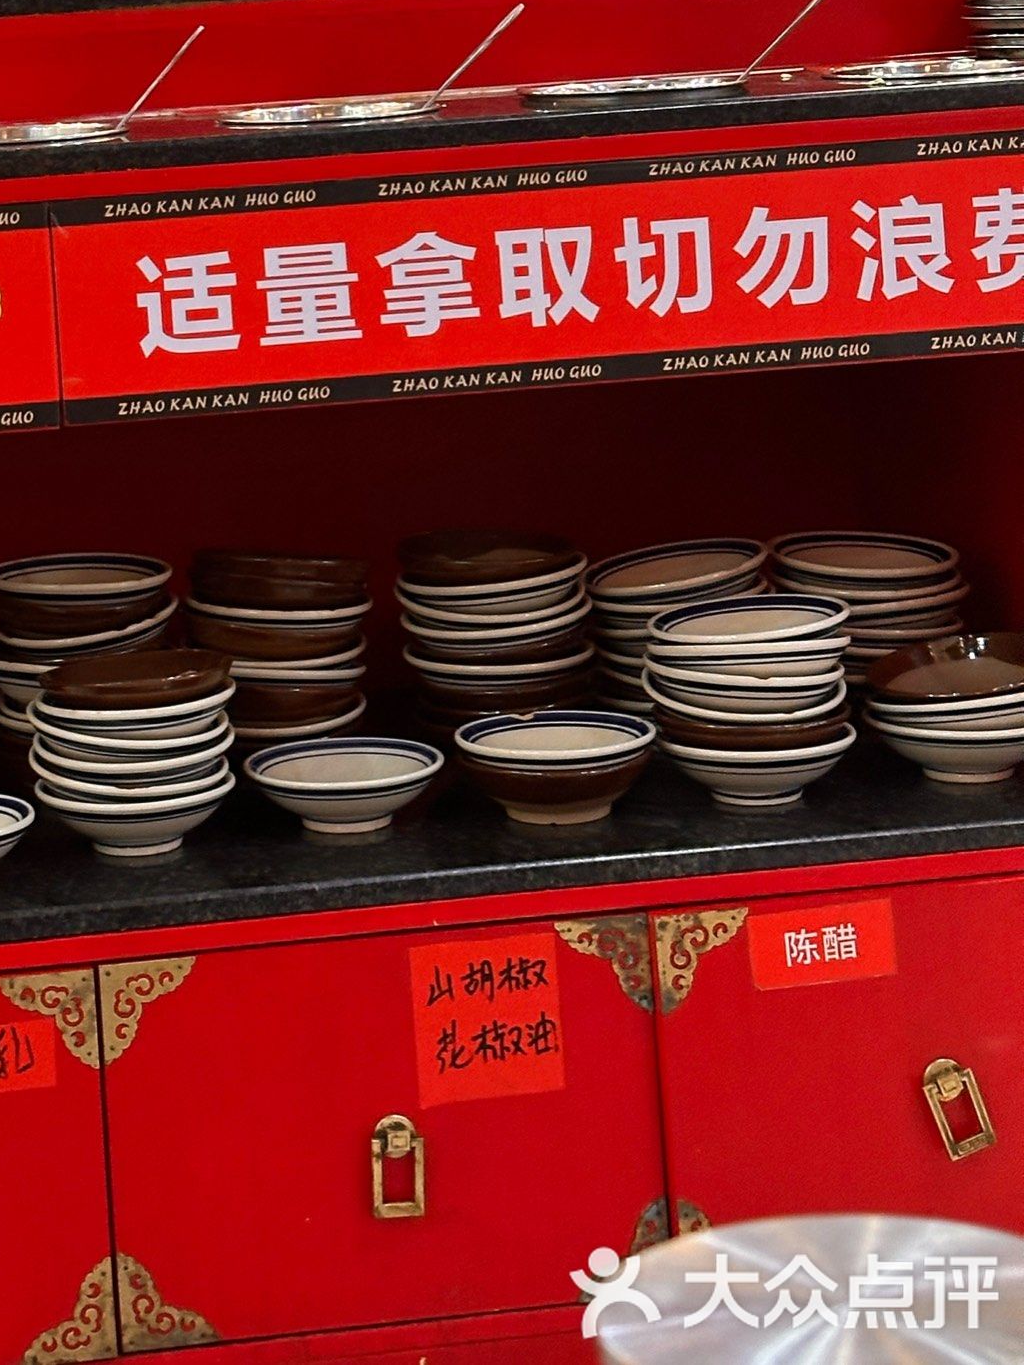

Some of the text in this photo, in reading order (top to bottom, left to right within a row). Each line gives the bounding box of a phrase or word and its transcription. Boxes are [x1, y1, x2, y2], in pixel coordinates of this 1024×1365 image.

[916, 140, 963, 156] ZHAO
[967, 137, 1004, 152] KAN
[648, 148, 856, 176] ZHAO KAN KAN HUO GUO
[378, 169, 588, 196] ZHAO KAN KAN HUO GUO
[104, 189, 316, 218] ZHAO KAN KAN HUO GUO
[930, 334, 977, 350] ZHAO
[980, 331, 1017, 346] KAN
[662, 342, 870, 371] ZHAO KAN KAN HUO GUO
[392, 364, 602, 393] ZHAO KAN KAN HUO GUO
[118, 385, 331, 416] ZHAO KAN KAN HUO GUO
[0, 410, 34, 426] GUO
[784, 922, 858, 968] 陈醋
[426, 957, 549, 1007] 山胡椒
[436, 1011, 560, 1075] 花椒油
